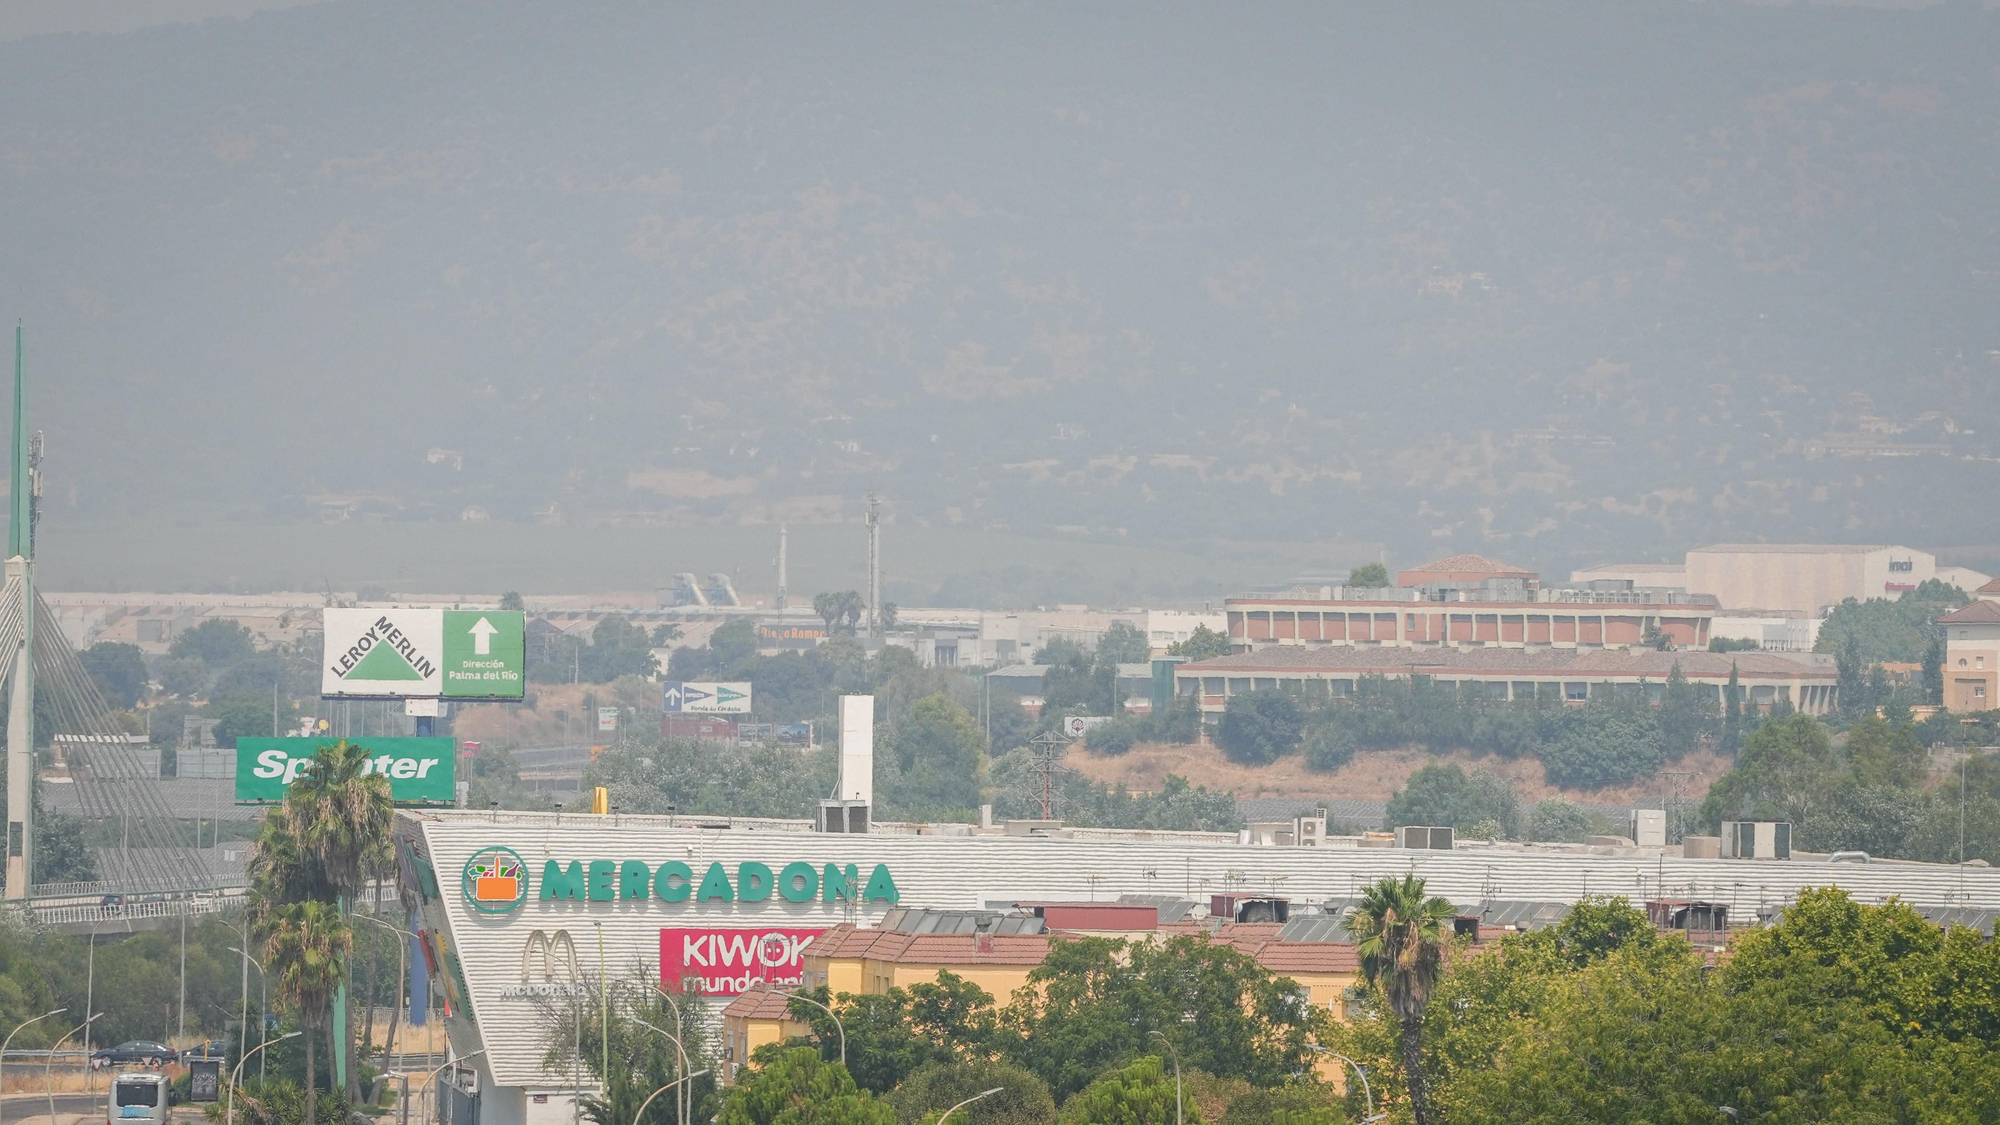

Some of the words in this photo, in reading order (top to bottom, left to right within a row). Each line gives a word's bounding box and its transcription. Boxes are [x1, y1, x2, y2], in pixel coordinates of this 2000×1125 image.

[331, 627, 379, 678] LEROY
[375, 616, 436, 678] MERLIN
[450, 671, 481, 680] Palma
[483, 671, 499, 680] del
[502, 670, 518, 681] Río
[462, 660, 504, 668] Dirección
[539, 860, 900, 903] MERCADONA
